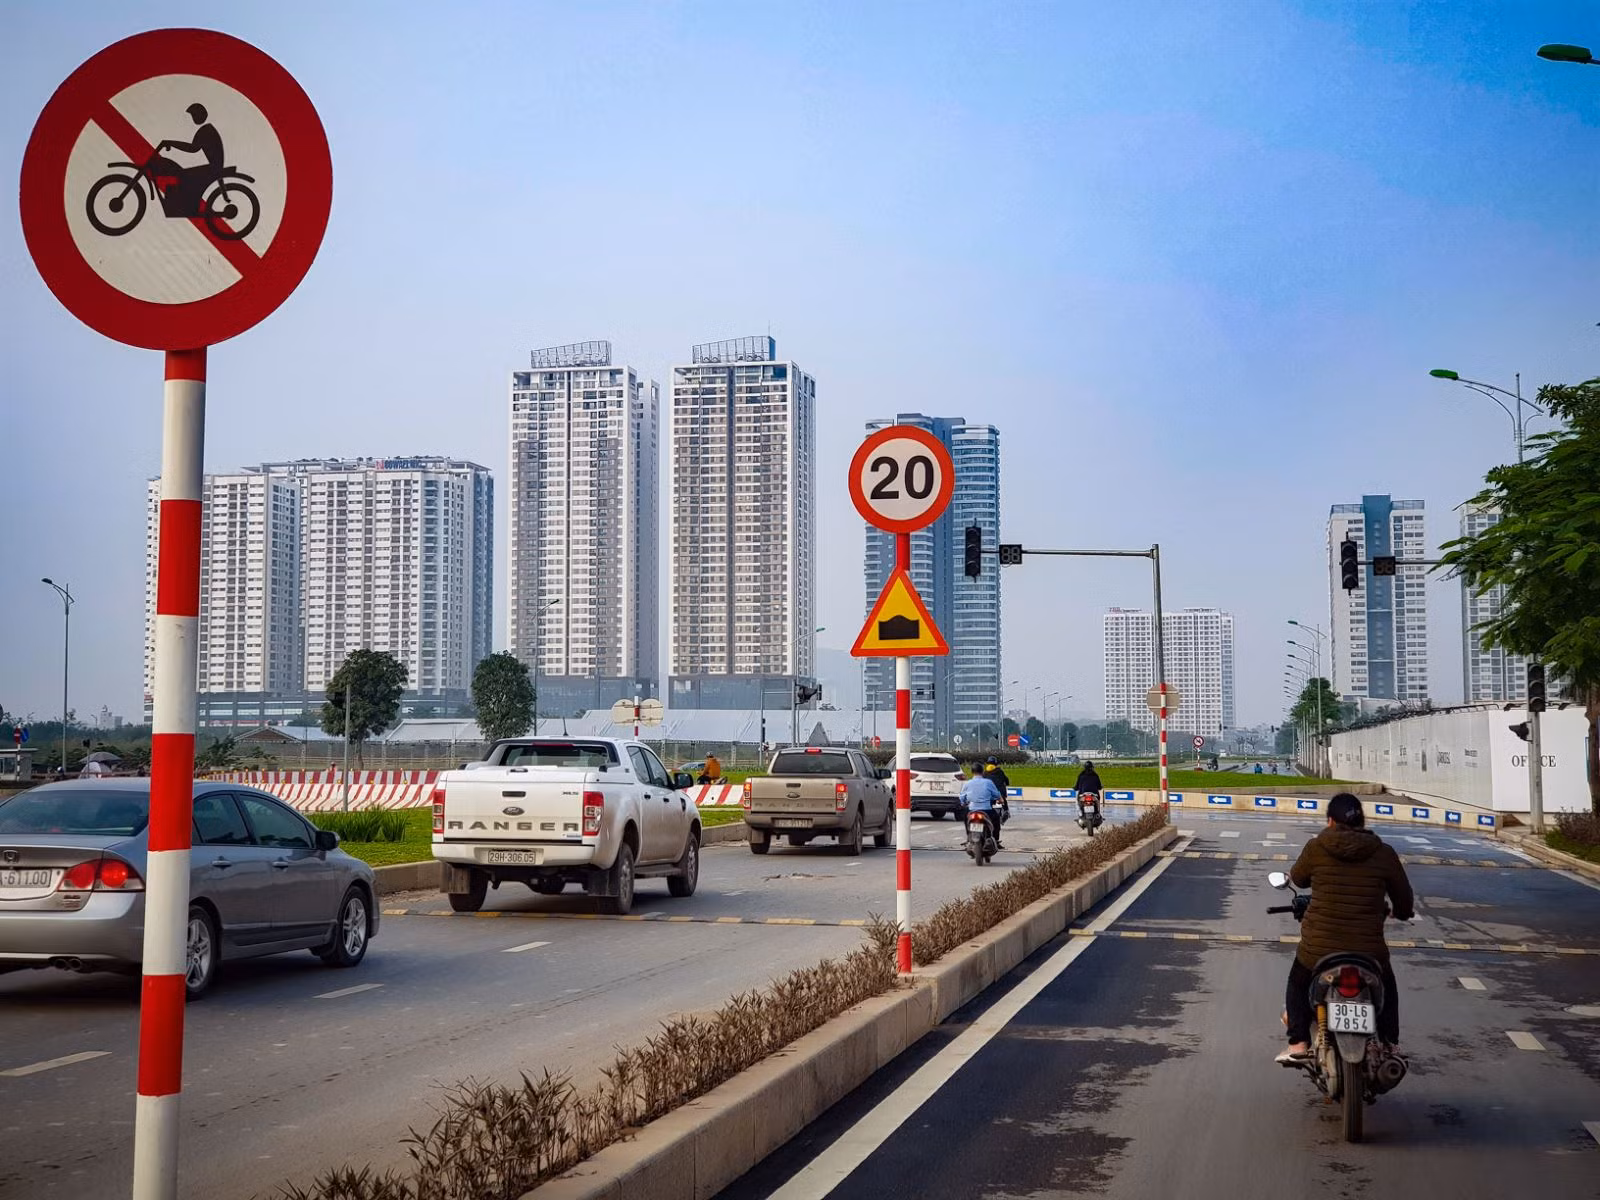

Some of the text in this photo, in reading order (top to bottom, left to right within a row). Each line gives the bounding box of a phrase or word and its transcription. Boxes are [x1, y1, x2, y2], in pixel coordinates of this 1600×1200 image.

[870, 455, 934, 500] 20
[1511, 755, 1557, 768] OFCE
[448, 821, 579, 831] RANGER
[1335, 1017, 1368, 1031] 7854
